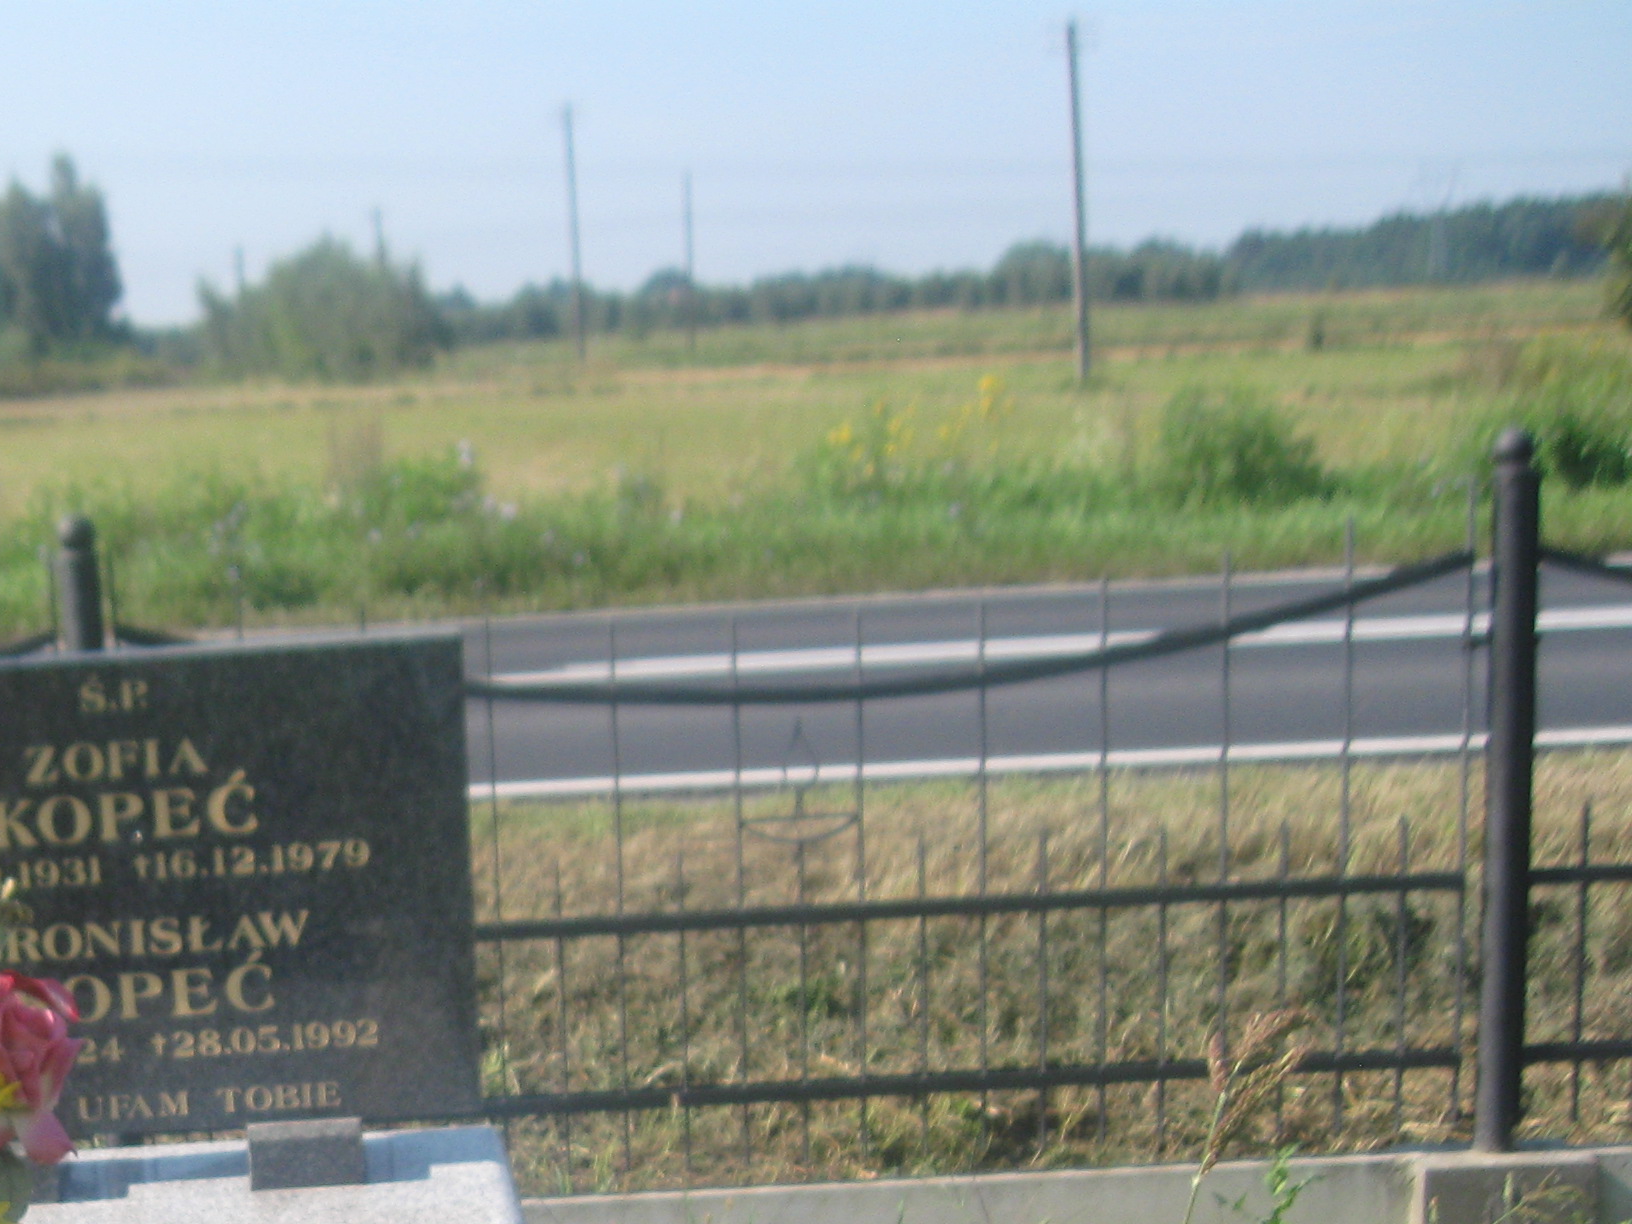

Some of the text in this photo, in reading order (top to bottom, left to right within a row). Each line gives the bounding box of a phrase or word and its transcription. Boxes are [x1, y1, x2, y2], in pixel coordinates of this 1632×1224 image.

[24, 737, 209, 786] ZOFIA
[64, 947, 277, 1024] OPEĆ
[77, 1081, 344, 1122] UFAM TOBIE
